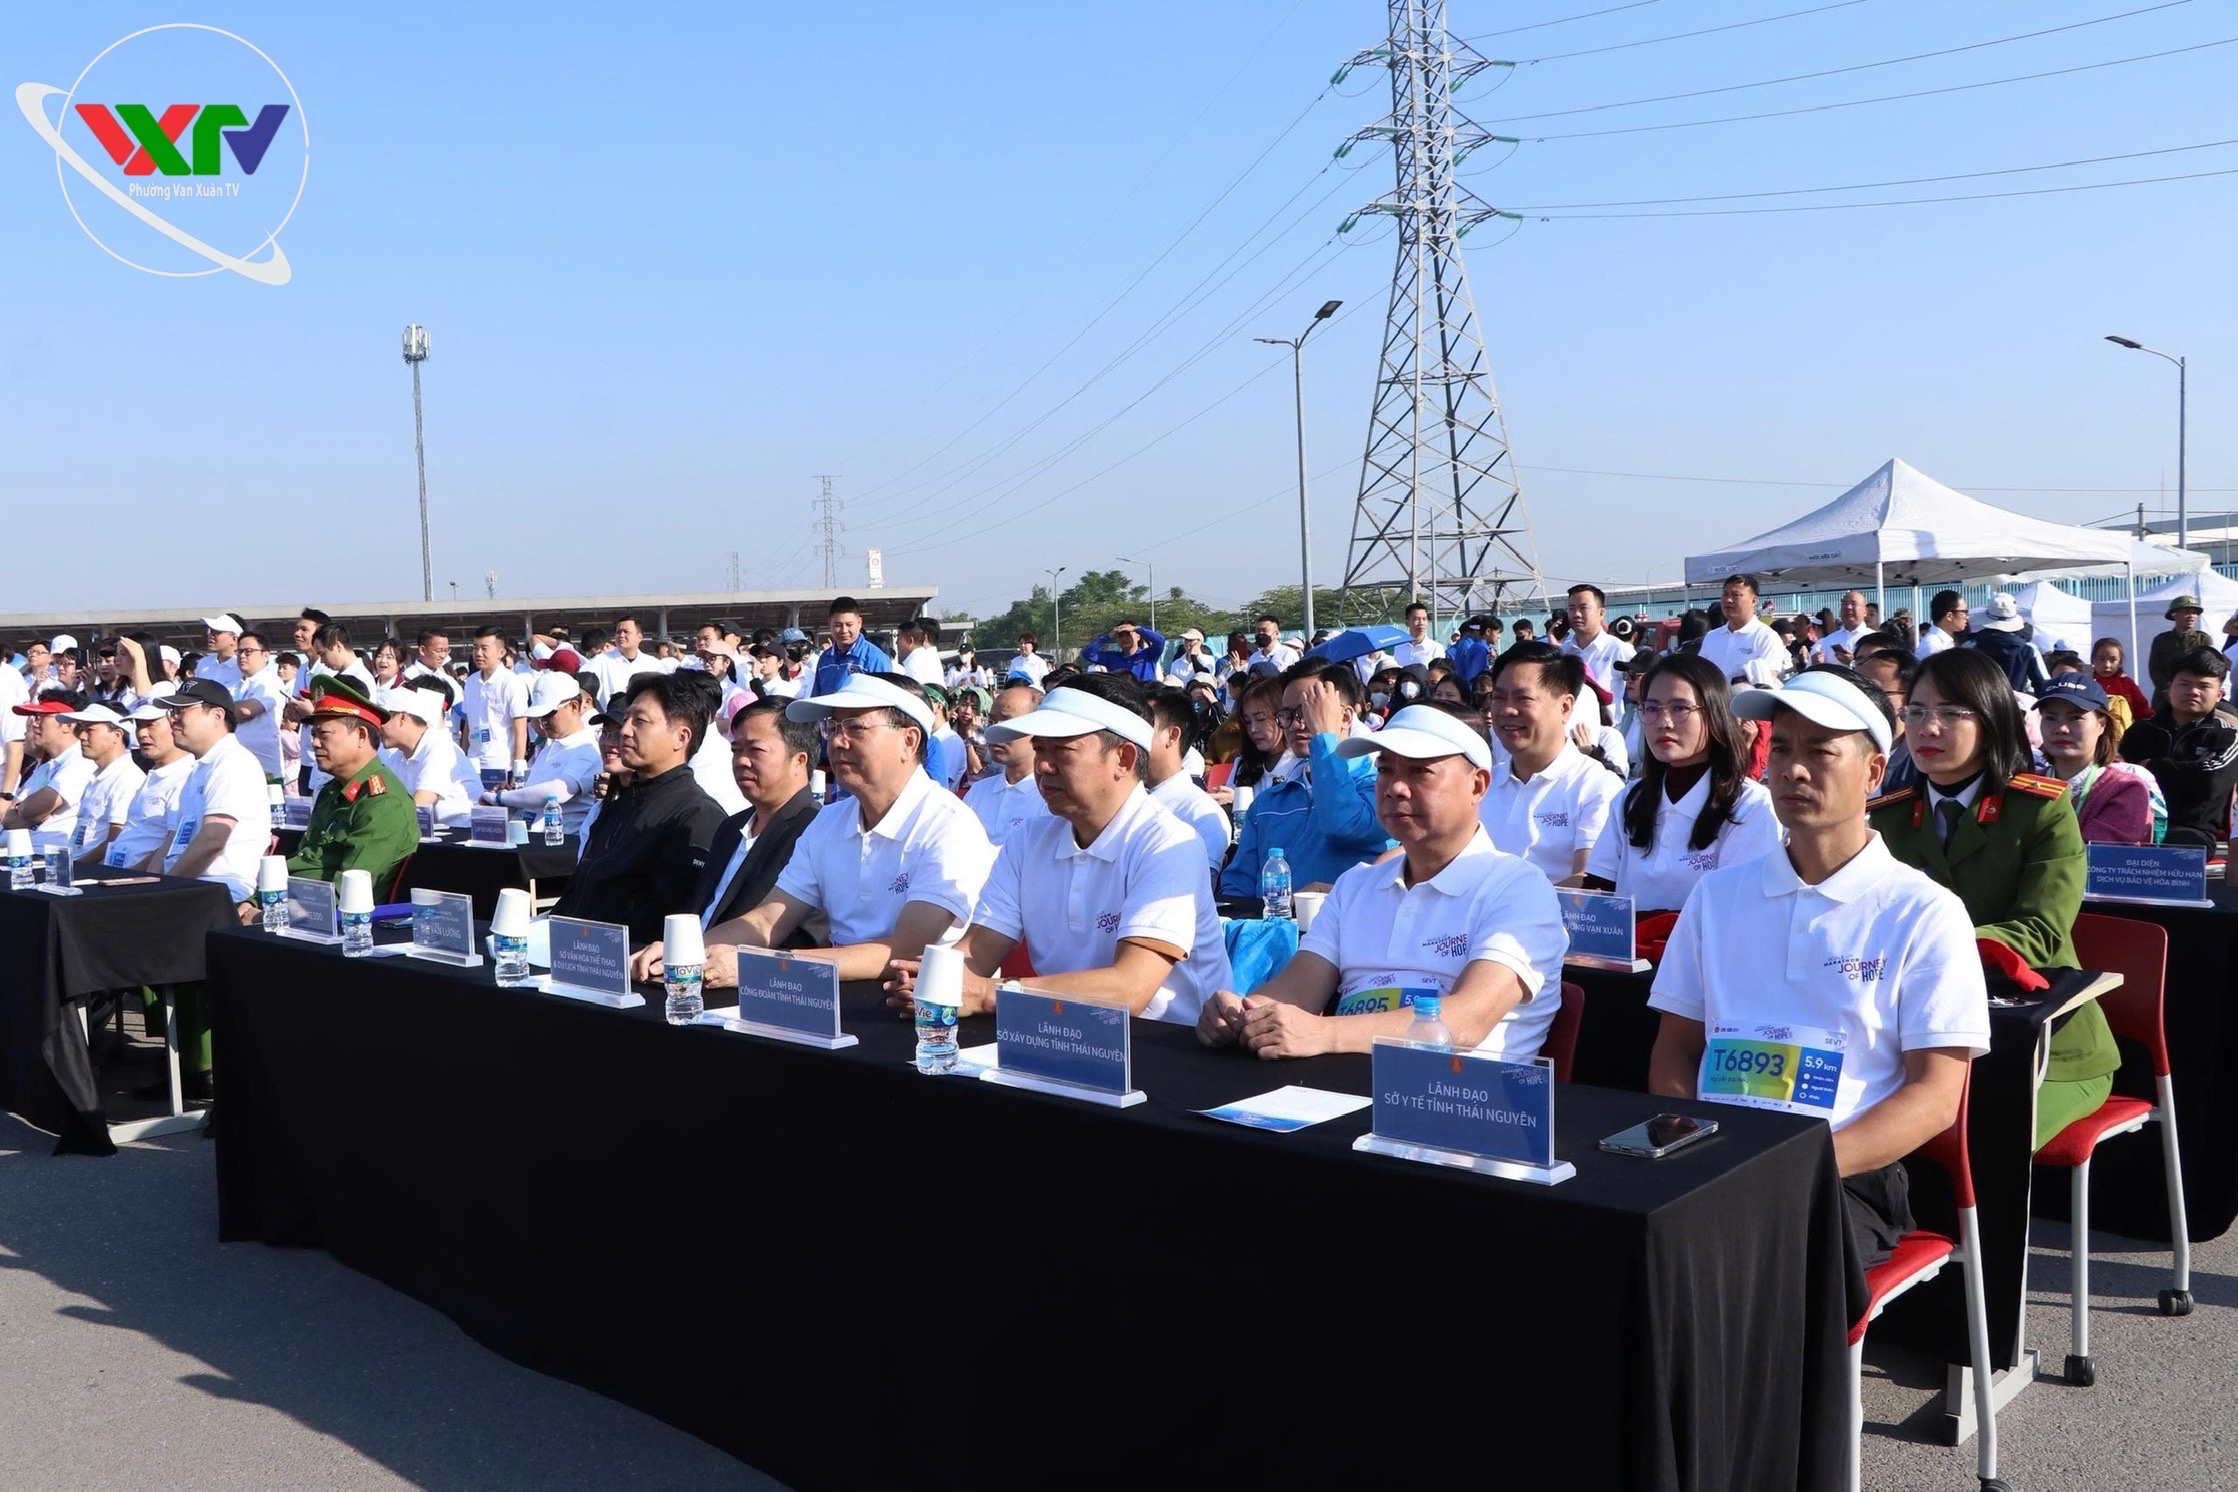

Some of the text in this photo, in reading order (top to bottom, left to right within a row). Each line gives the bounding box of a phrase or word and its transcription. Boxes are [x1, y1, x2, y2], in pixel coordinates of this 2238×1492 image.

[2140, 859, 2159, 868] DIỆN
[1580, 914, 1596, 924] ĐẠO
[1586, 925, 1601, 934] VẠN
[1602, 925, 1624, 936] XUÂN
[574, 940, 600, 954] LÃNH ĐẠO
[1434, 934, 1468, 954] JOURNE
[1441, 943, 1466, 958] OF HOP
[568, 951, 578, 960] VĂN
[602, 958, 616, 968] THAO
[1824, 958, 1860, 967] MARATHON
[1838, 958, 1888, 974] JOURNEY
[558, 961, 564, 969] DU
[566, 962, 576, 972] LỊCH
[590, 966, 600, 976] THÁI
[602, 968, 624, 980] NGUYÊN
[1862, 968, 1884, 982] HOPE
[768, 978, 802, 994] LÃNH ĐẠO
[740, 986, 834, 1011] CÔNG ĐOÀN TỈNH THÁI NGUYÊN
[1038, 1021, 1082, 1040] LÃNH ĐẠO
[997, 1028, 1126, 1062] SỞ XÂY DỰNG TỈNH THÁI NGUYÊN
[1824, 1037, 1842, 1046] SEVT
[1714, 1049, 1784, 1076] T6893
[1804, 1055, 1837, 1072] 5.9 km
[1526, 1074, 1543, 1086] HOPE
[1428, 1081, 1488, 1104] LÃNH ĐẠO
[1384, 1091, 1536, 1128] SỞ Y TẾ TỈNH THÁI NGUYÊN
